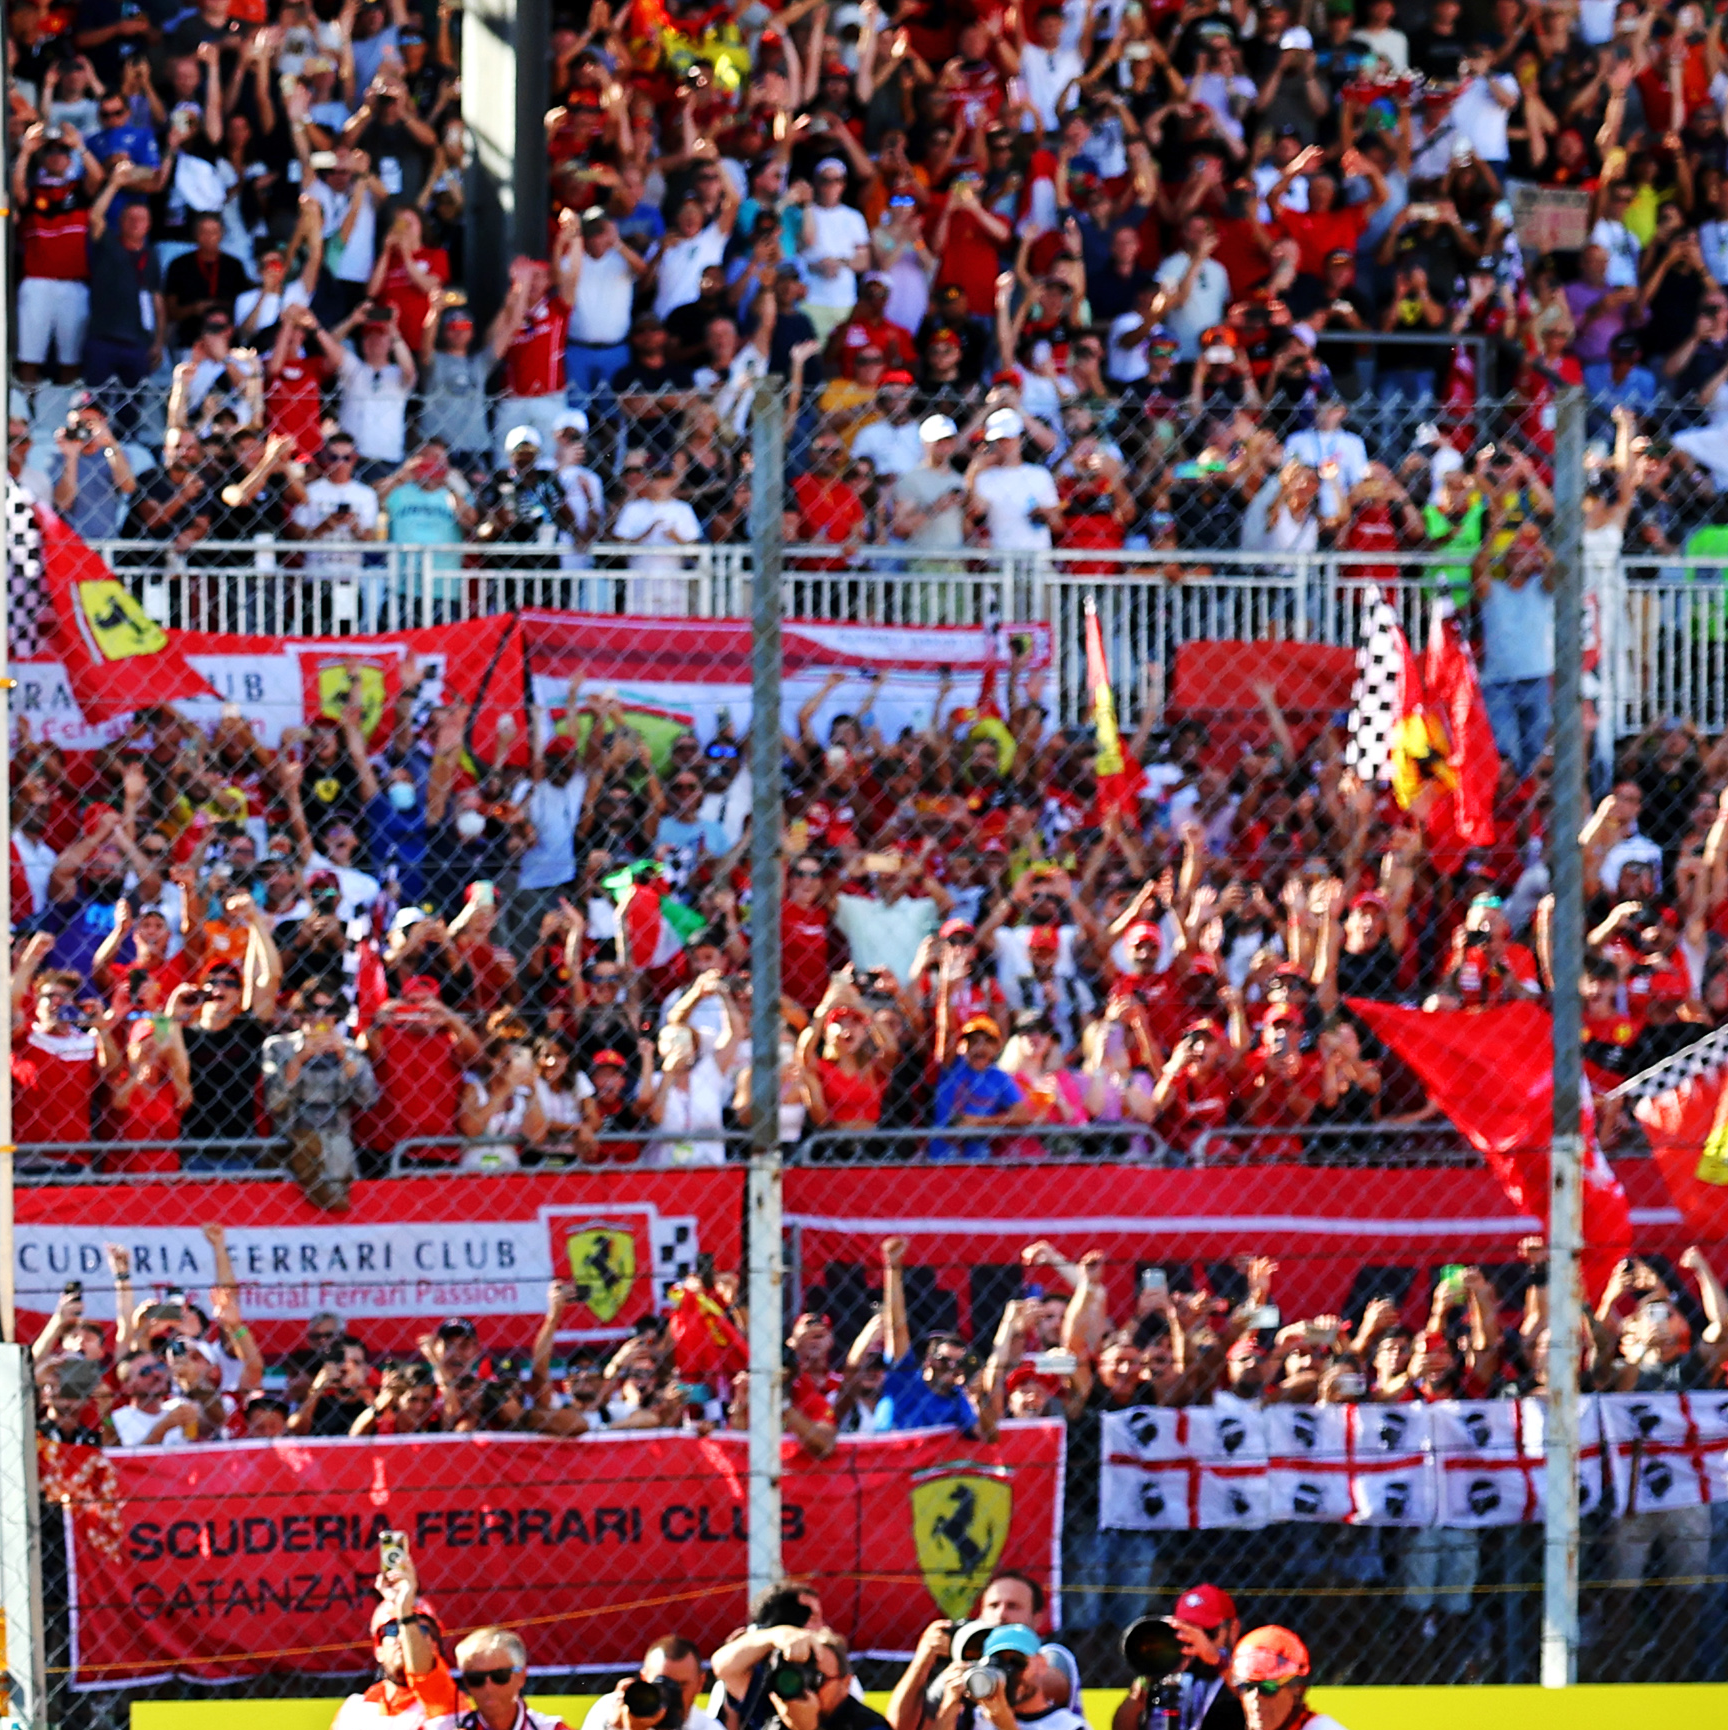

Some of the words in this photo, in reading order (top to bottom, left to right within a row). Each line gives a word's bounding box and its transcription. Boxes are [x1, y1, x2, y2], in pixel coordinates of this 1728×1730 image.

[414, 1239, 518, 1272] CLUB
[318, 1279, 409, 1308] Ferrari
[414, 1278, 519, 1304] Passion
[128, 1513, 391, 1562] SCUDERIA
[415, 1505, 647, 1551] FERRARI
